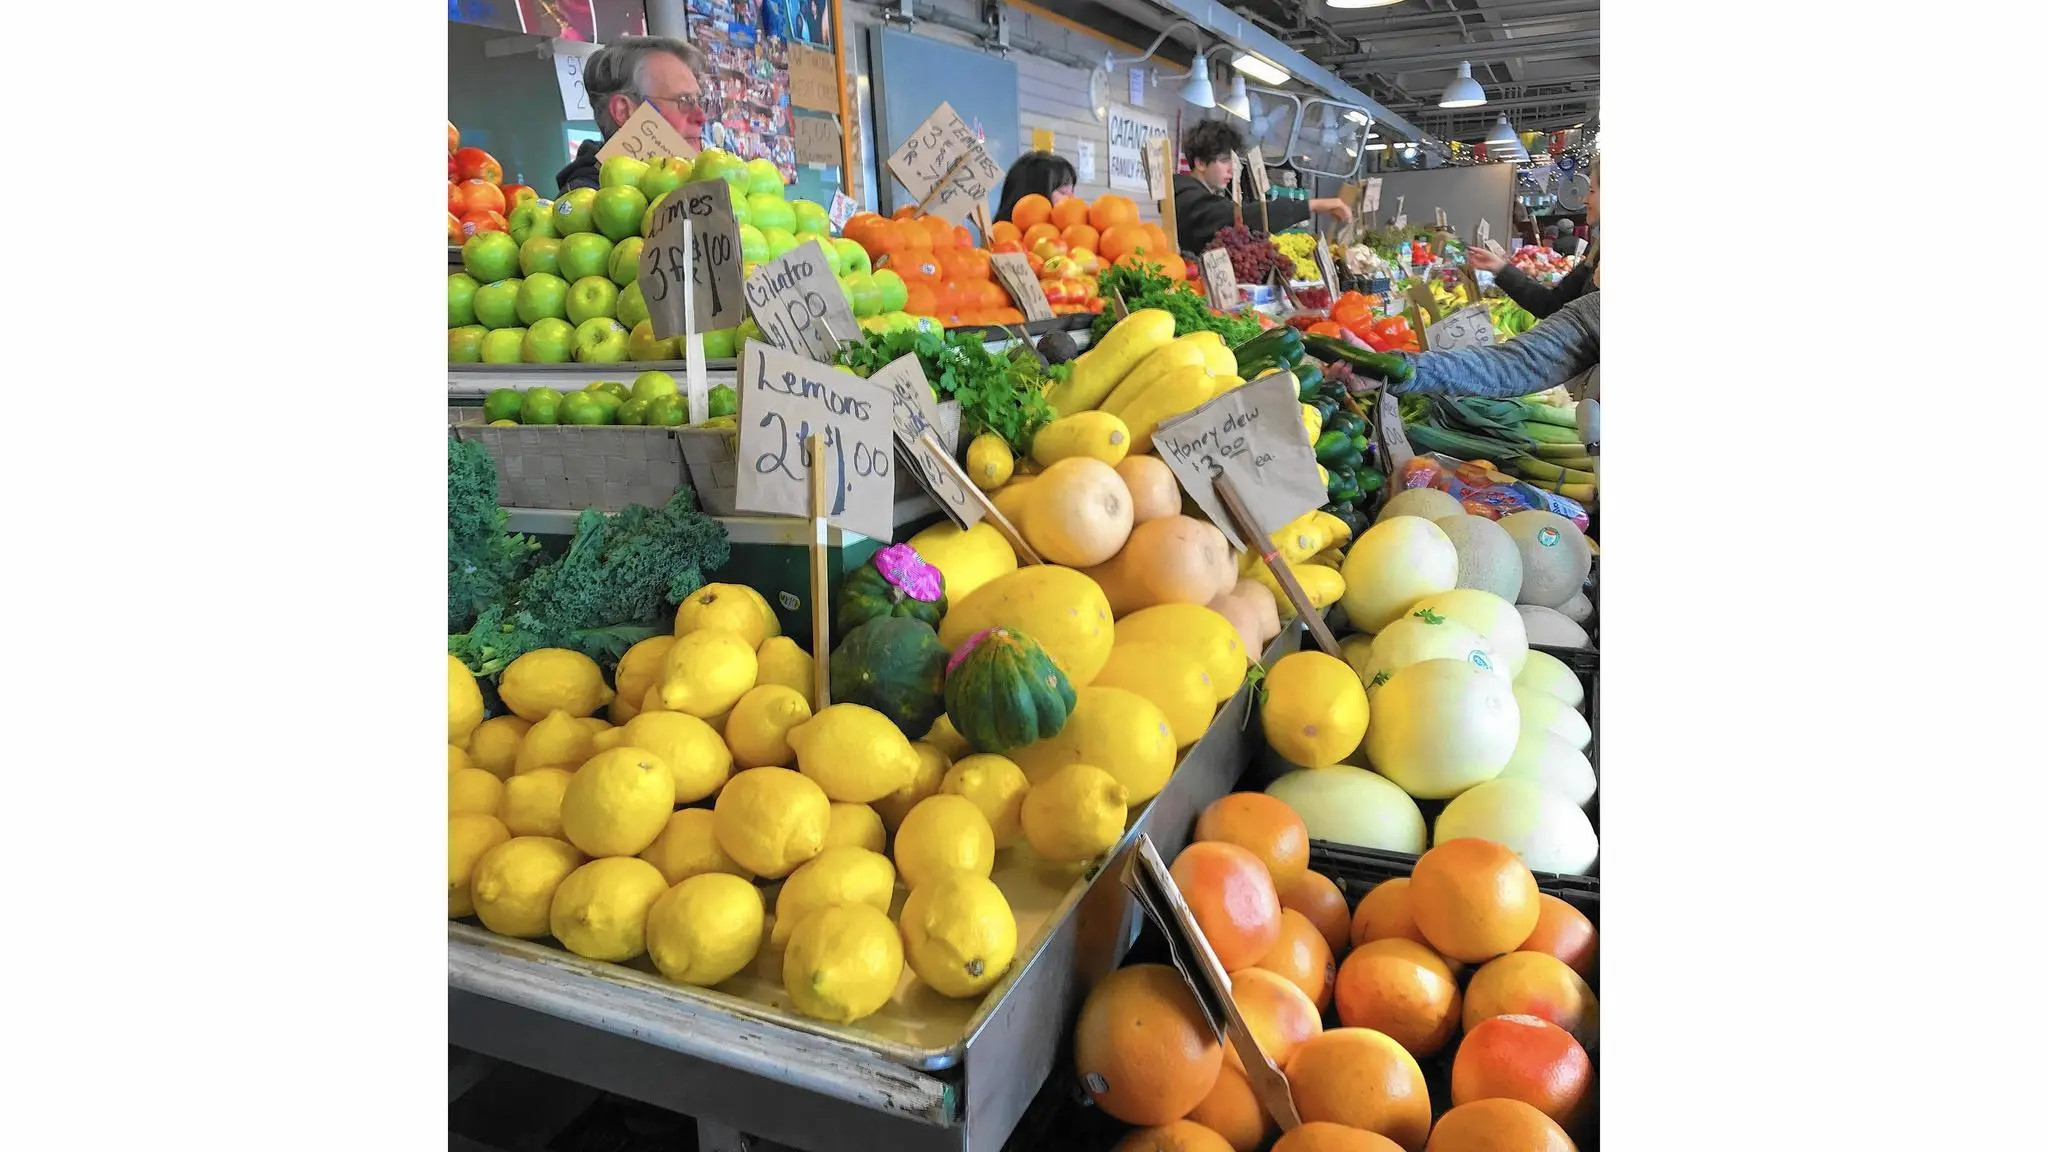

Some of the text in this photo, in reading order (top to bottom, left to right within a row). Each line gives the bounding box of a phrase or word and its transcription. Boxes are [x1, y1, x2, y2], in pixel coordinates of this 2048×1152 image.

[648, 194, 713, 239] Limes
[648, 246, 669, 302] 3
[757, 349, 872, 421] Lemons
[755, 411, 805, 482] 2
[823, 422, 889, 516] $1.00
